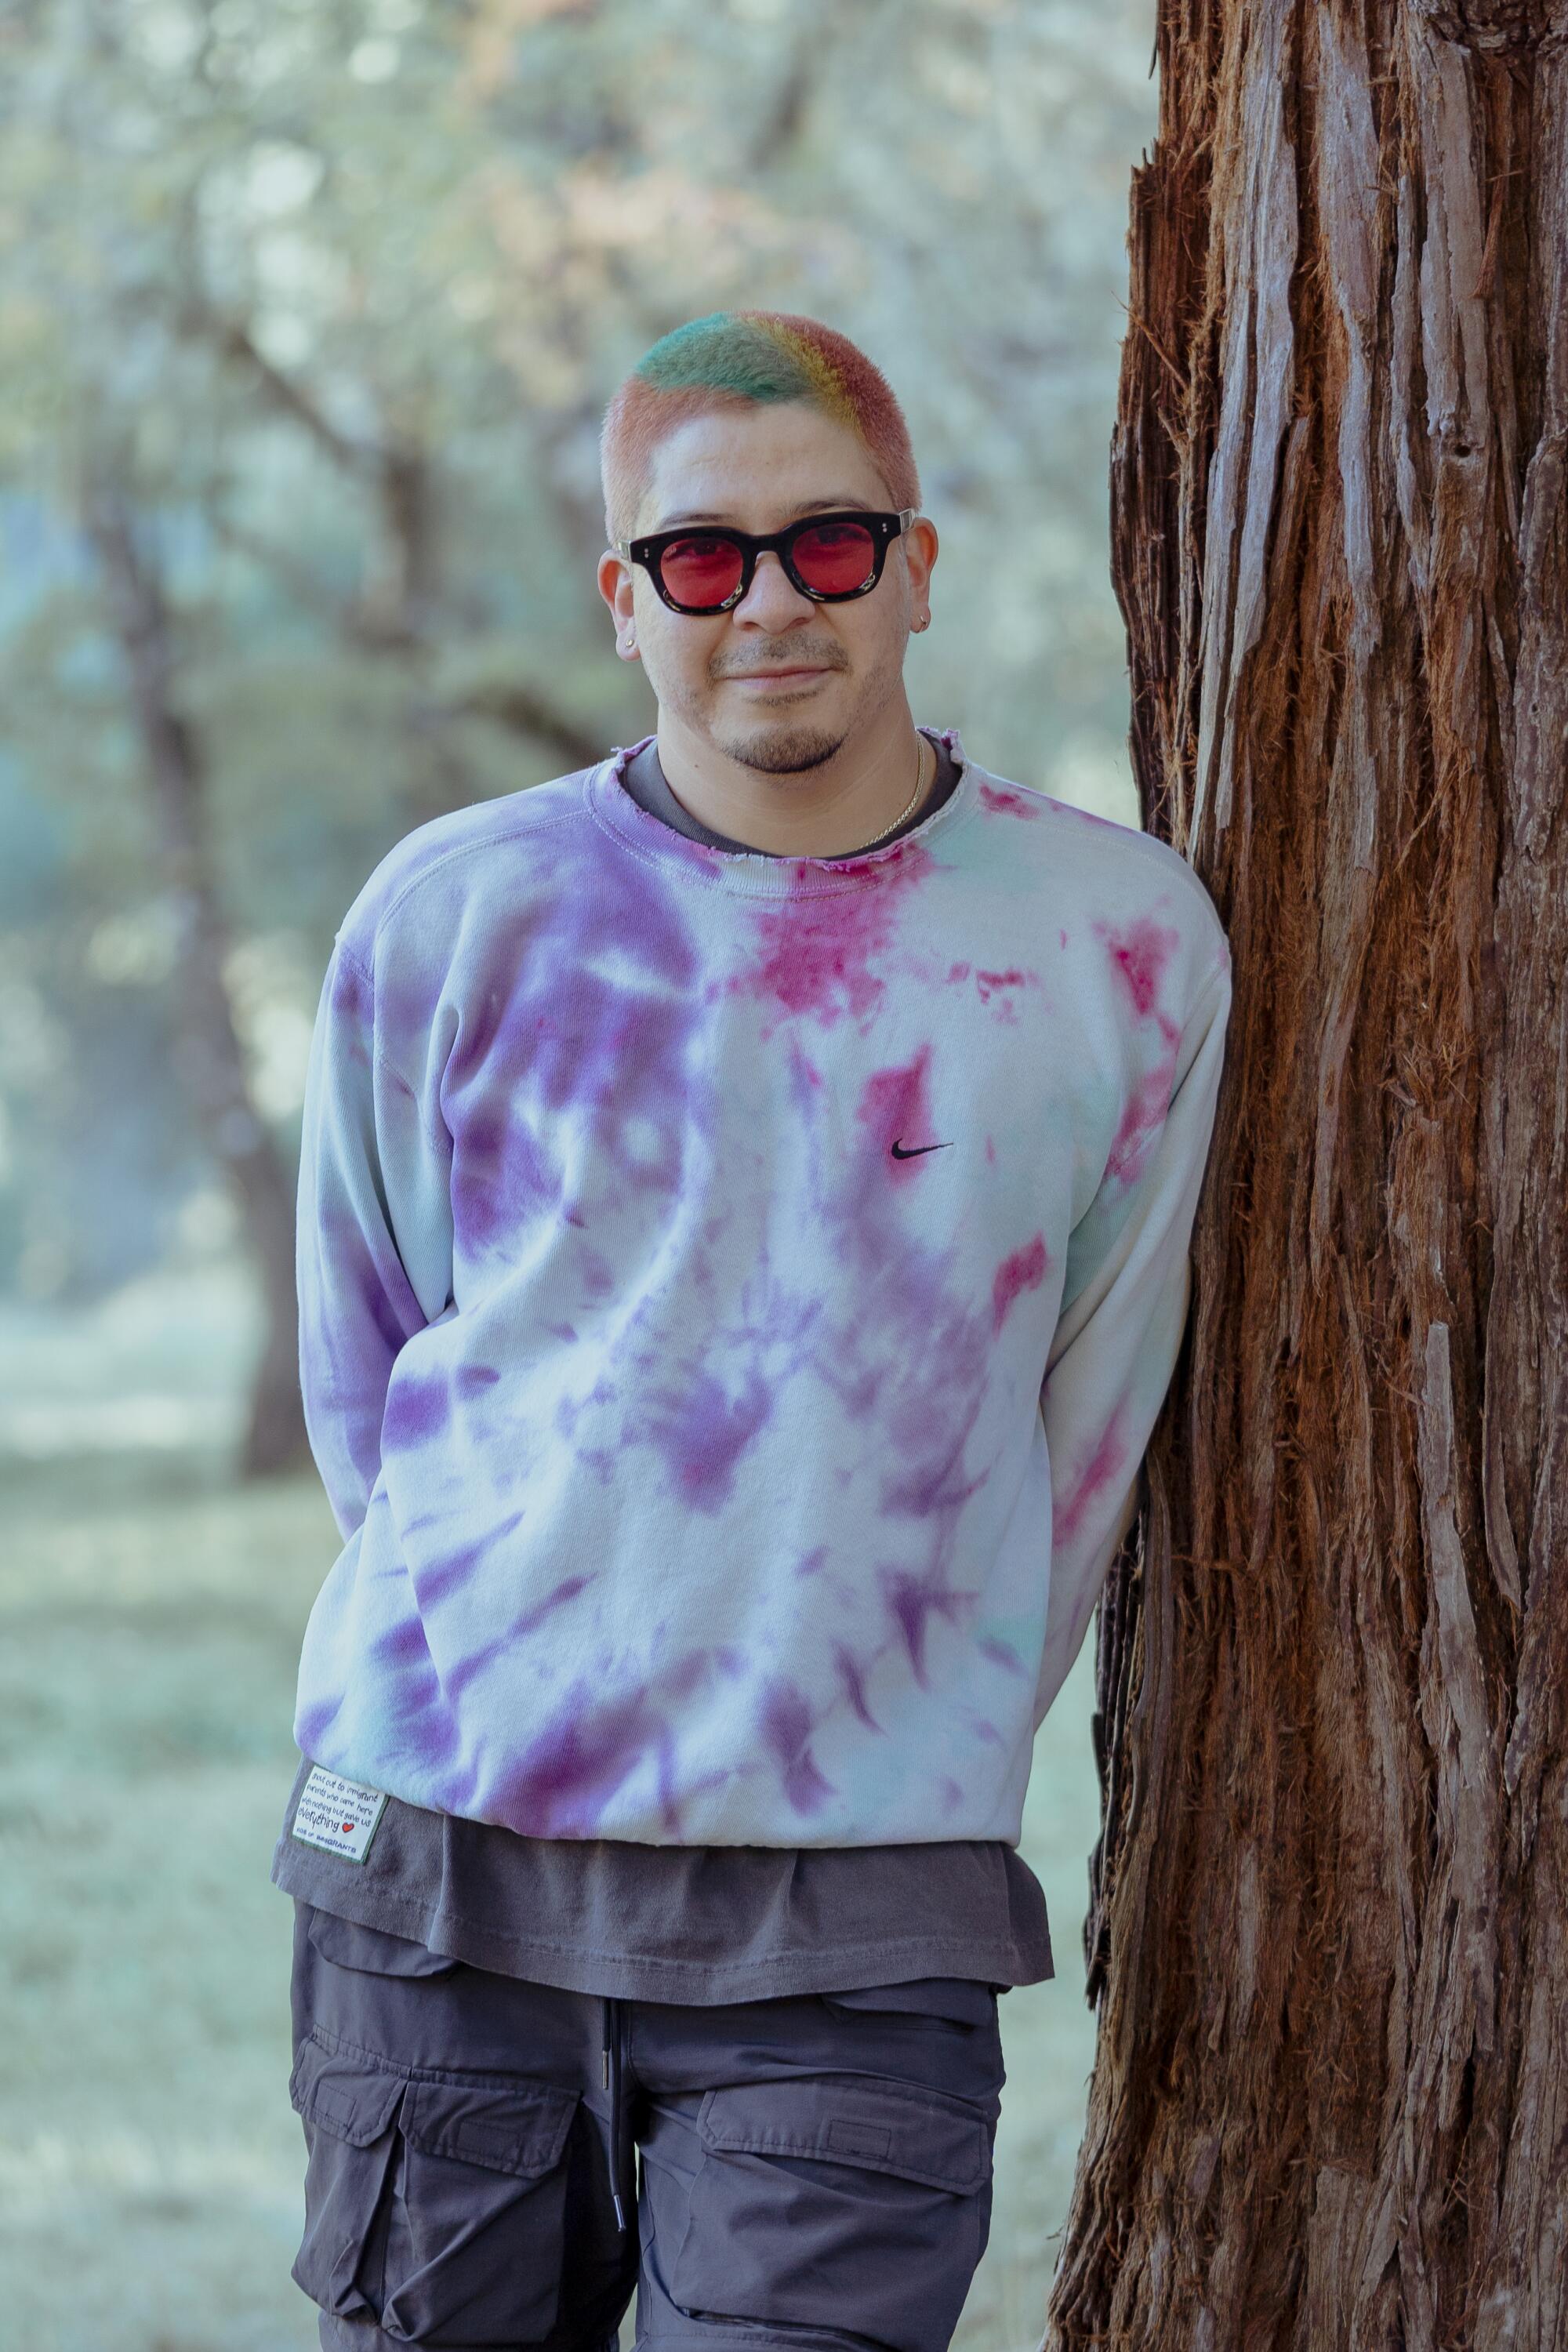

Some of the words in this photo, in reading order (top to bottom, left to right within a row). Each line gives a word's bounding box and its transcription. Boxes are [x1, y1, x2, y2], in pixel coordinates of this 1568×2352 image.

[307, 1784, 326, 1797] parents
[326, 1792, 339, 1802] who
[340, 1798, 354, 1806] came
[357, 1803, 373, 1816] here
[337, 1782, 345, 1791] to
[347, 1785, 378, 1802] immigrant
[298, 1806, 340, 1833] everything
[301, 1795, 312, 1806] with
[312, 1801, 331, 1813] nothing
[332, 1806, 344, 1817] but
[345, 1813, 359, 1822] gave
